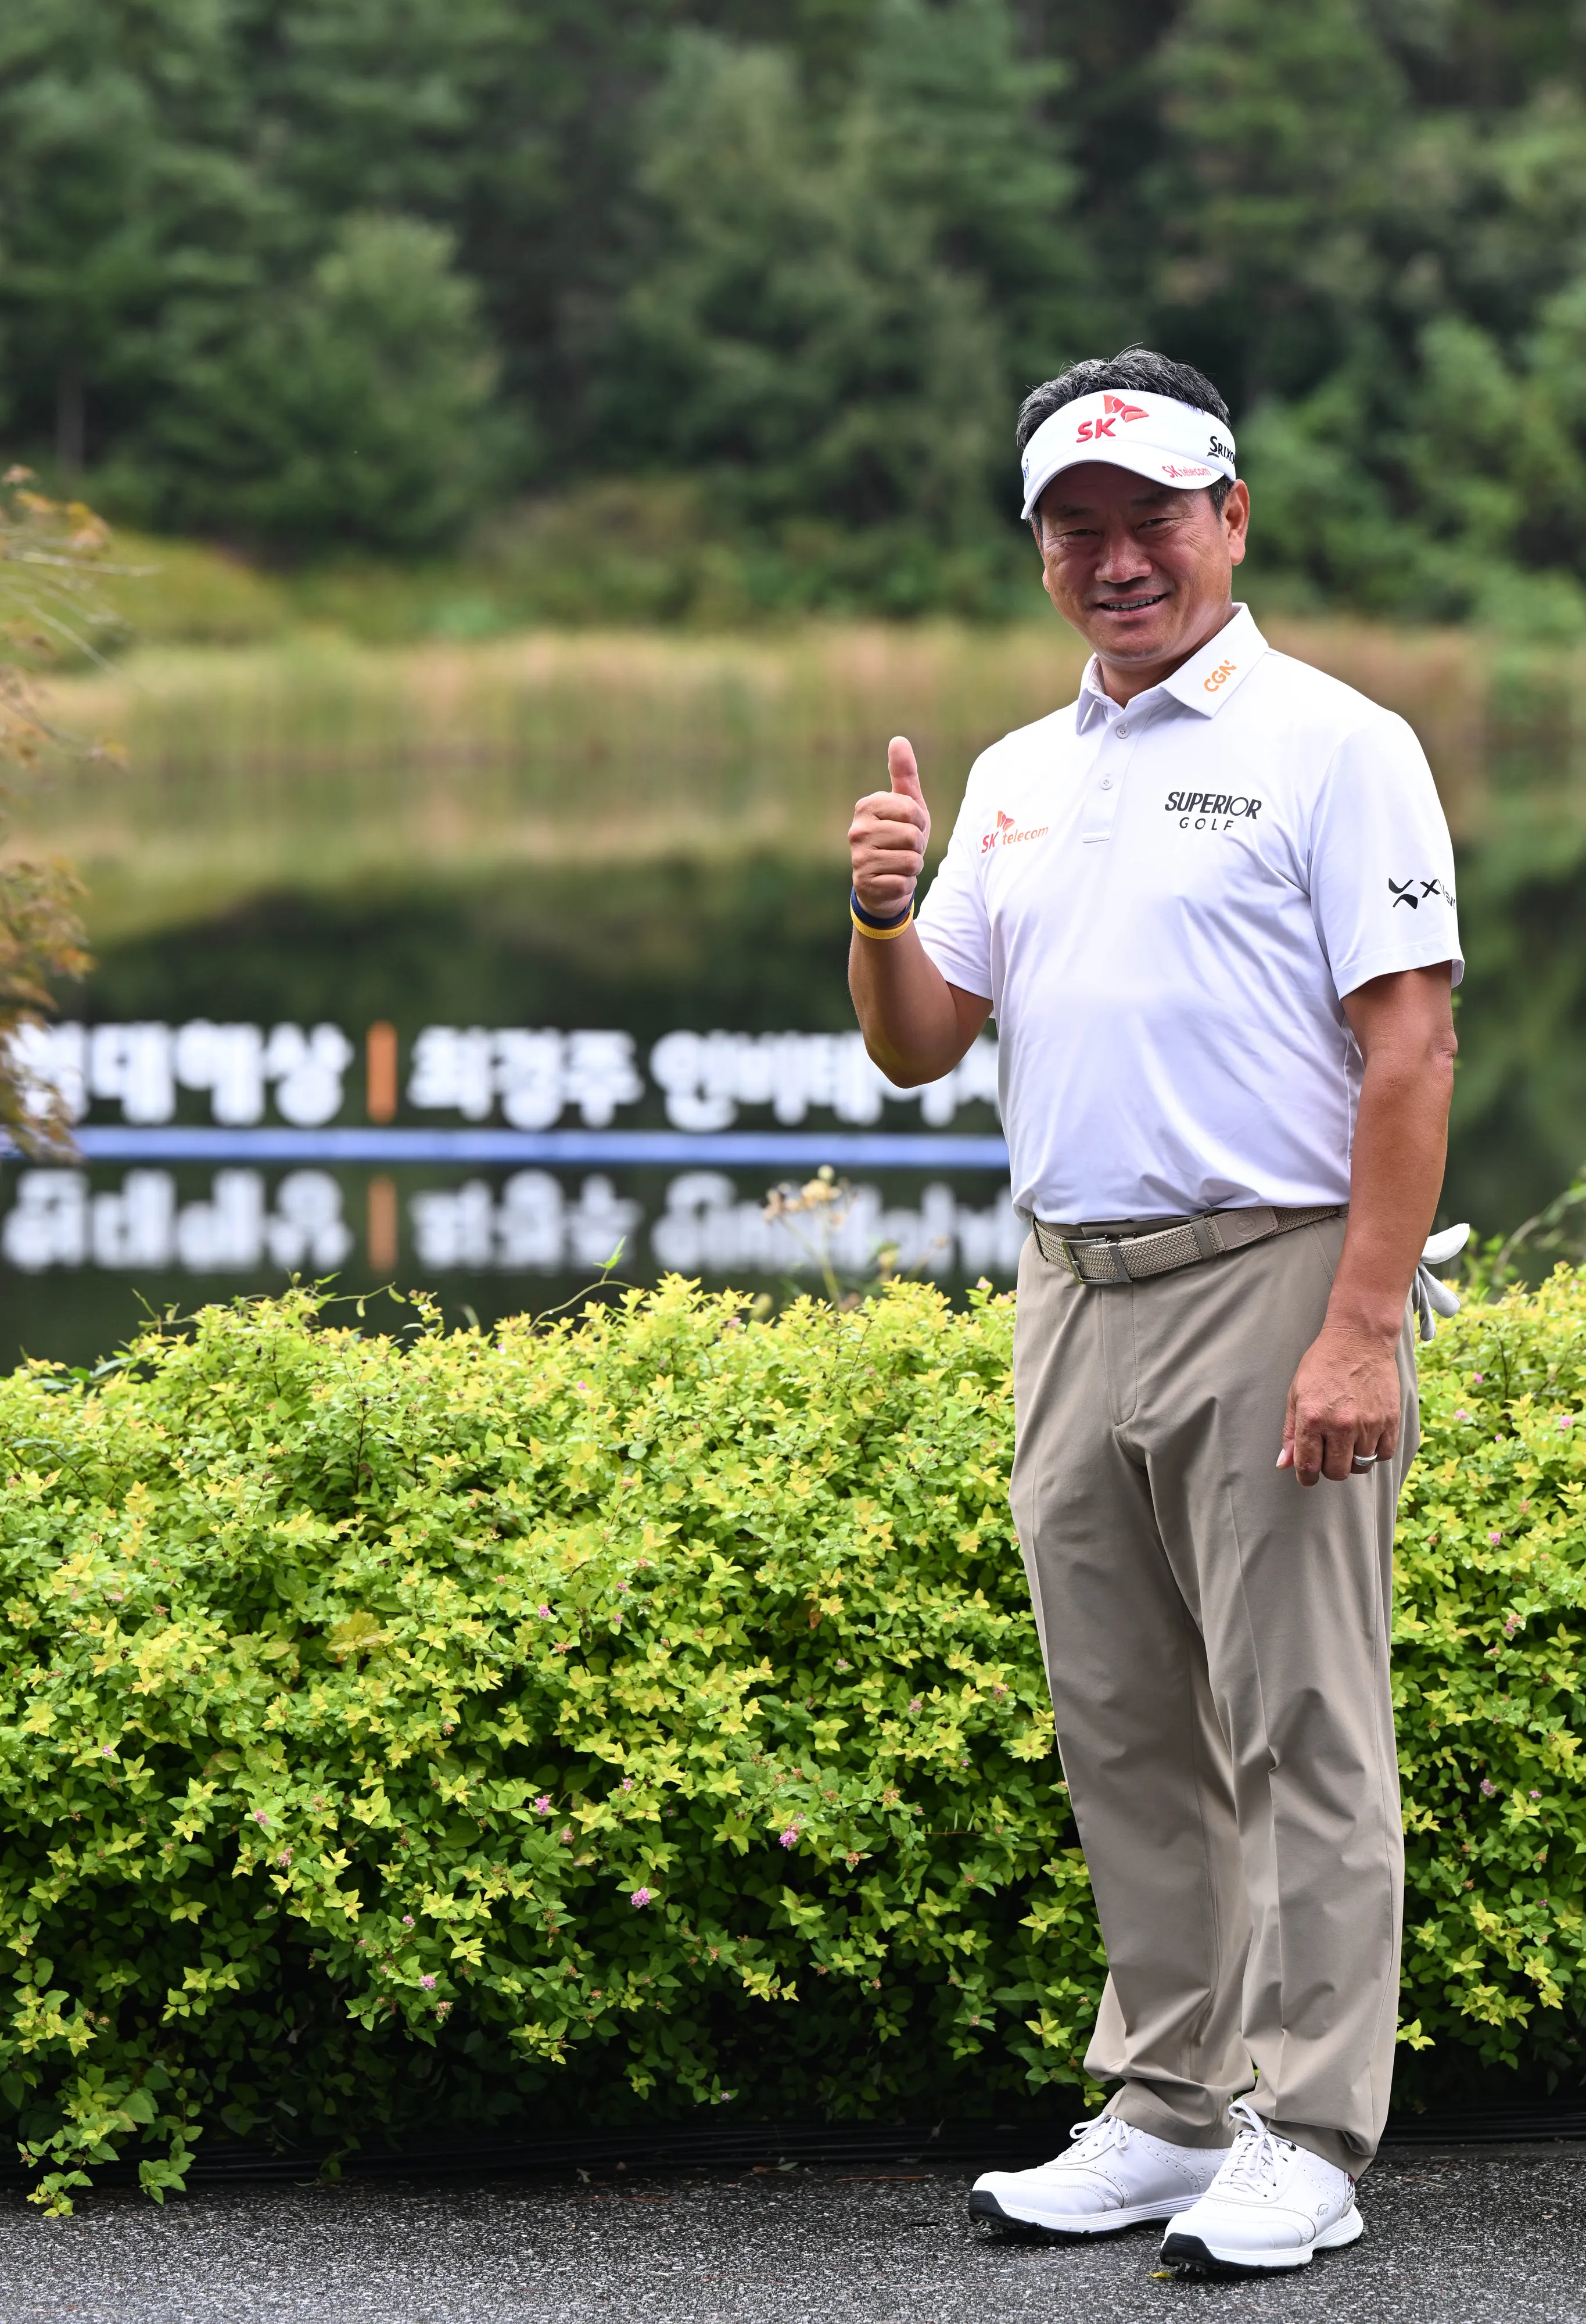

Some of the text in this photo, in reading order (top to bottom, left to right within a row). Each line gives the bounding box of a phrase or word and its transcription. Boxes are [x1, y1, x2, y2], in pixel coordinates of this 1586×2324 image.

[1076, 418, 1116, 443] SK
[1162, 465, 1211, 478] SK telecom
[1165, 791, 1262, 820] SUPERIOR
[1179, 817, 1234, 831] GOLF
[981, 827, 1049, 853] SK telecom
[1314, 2203, 1330, 2217] Vainer
